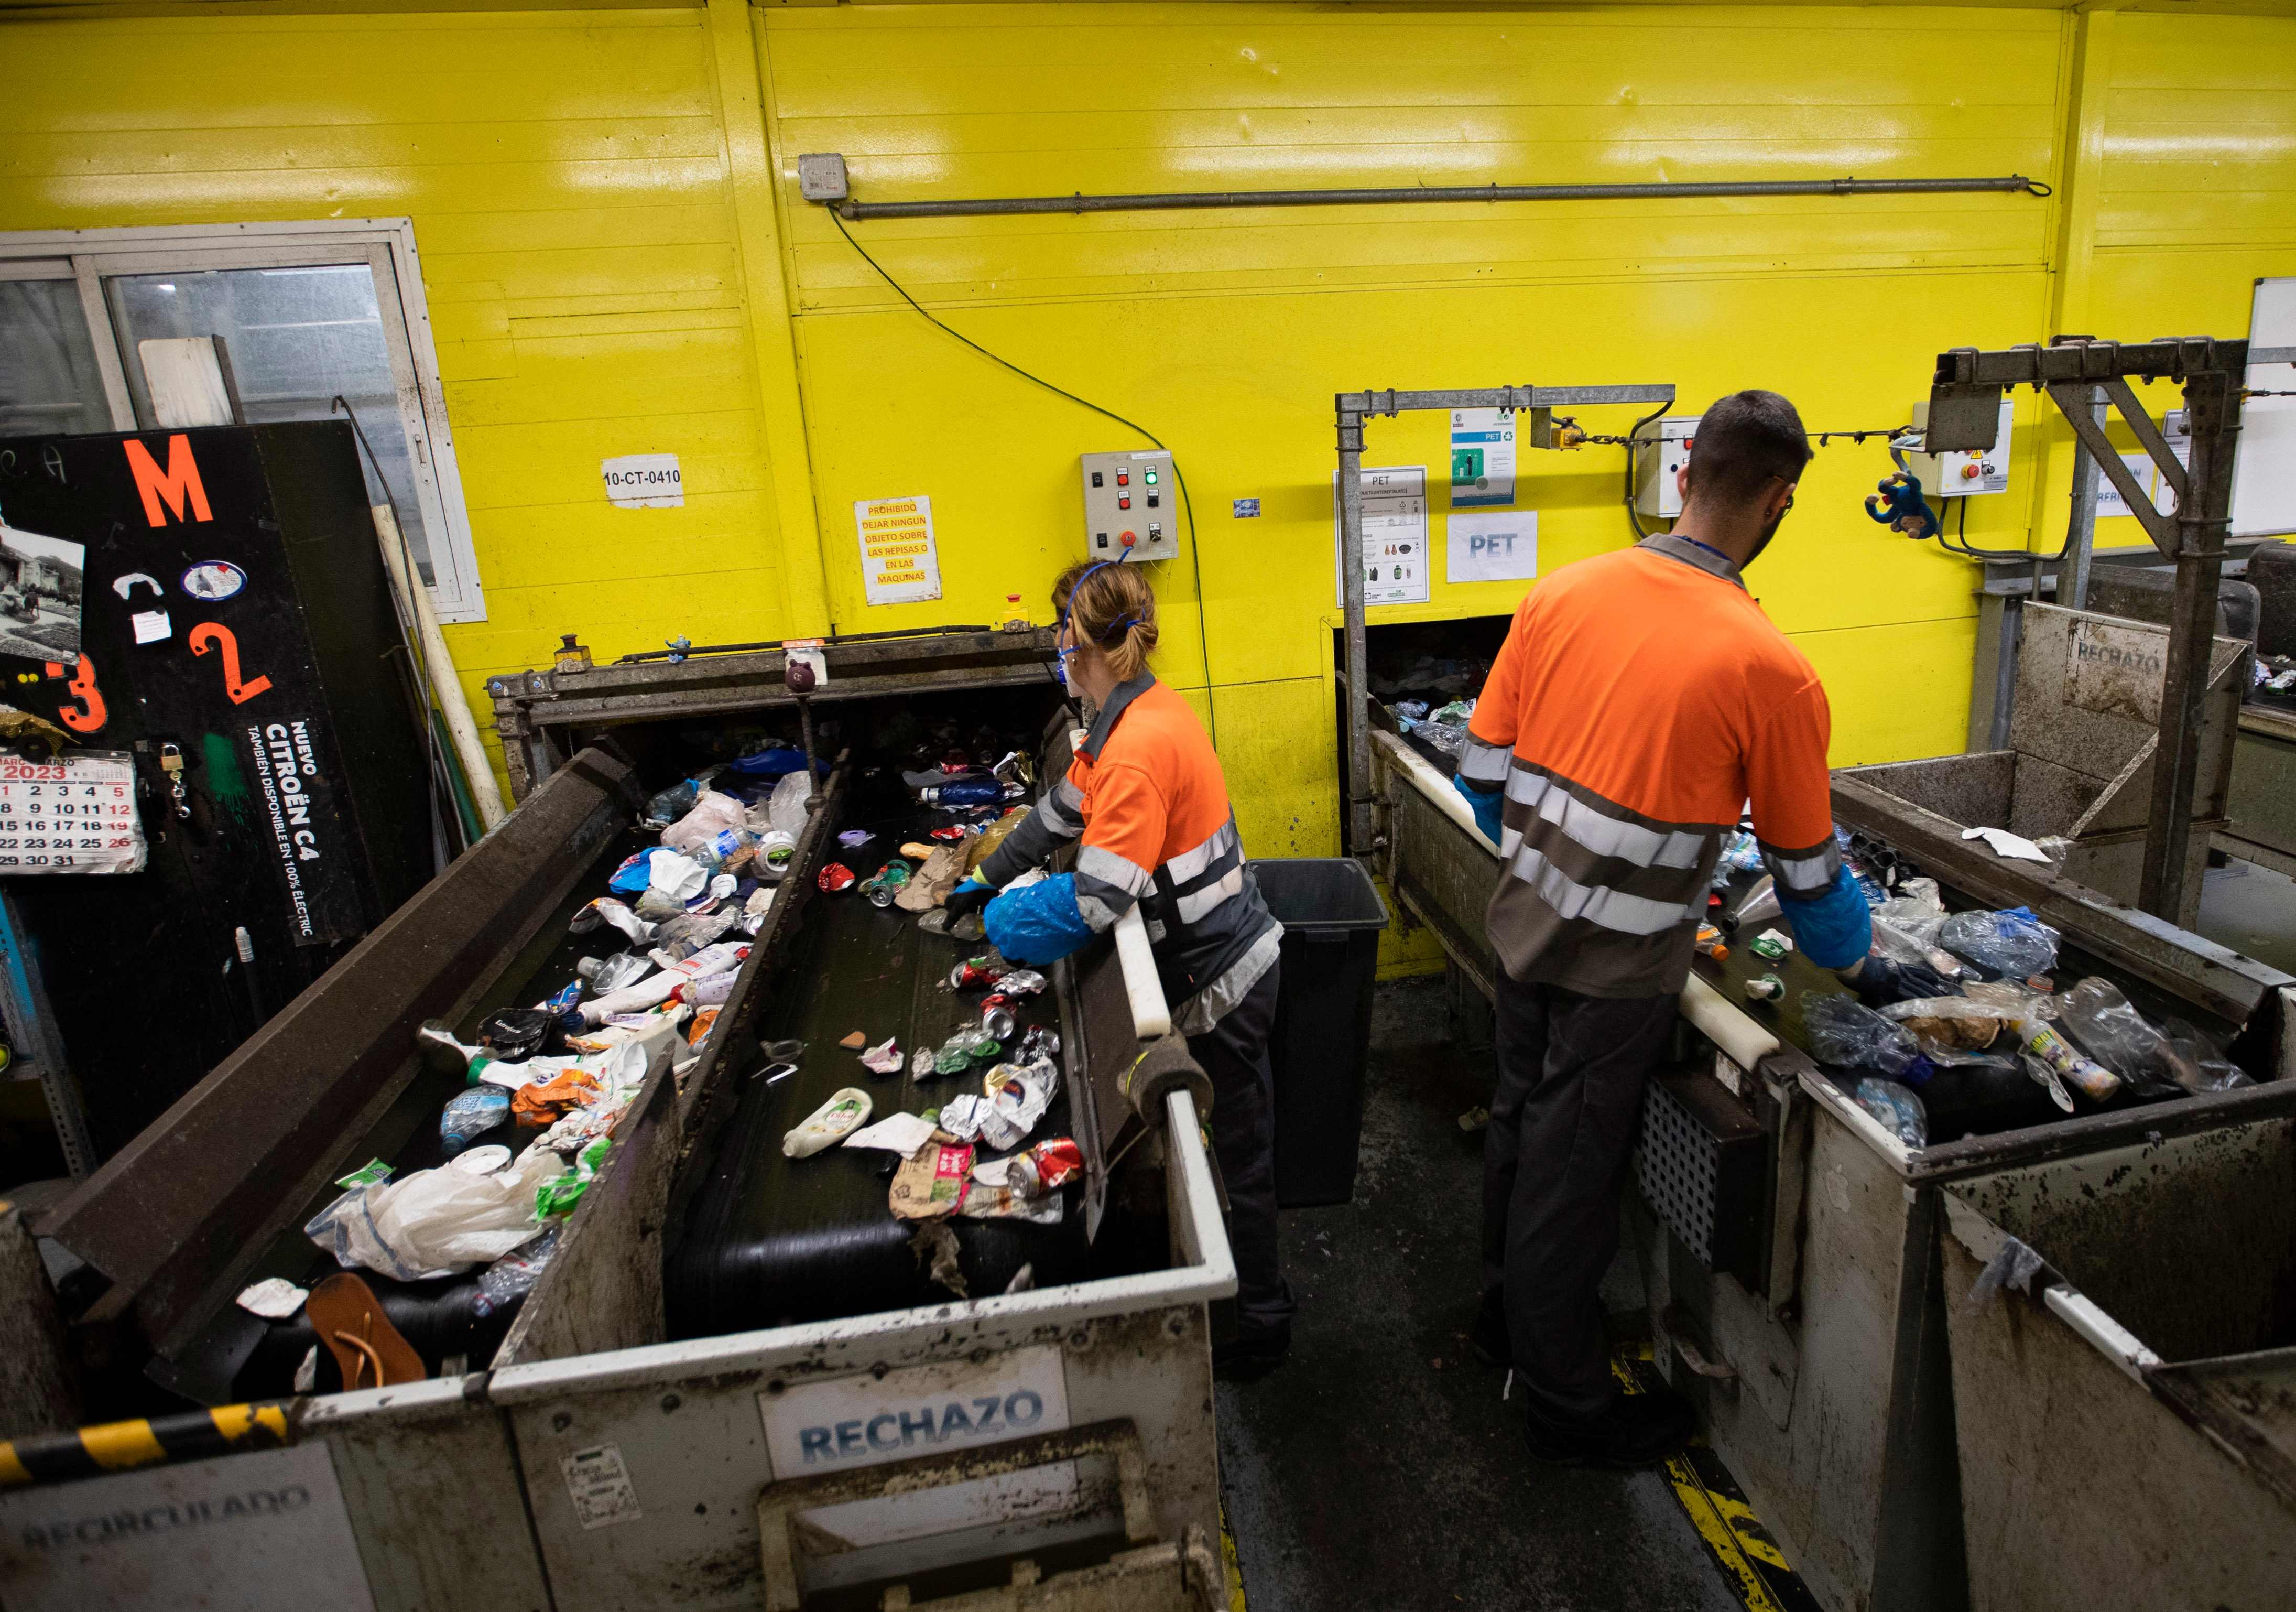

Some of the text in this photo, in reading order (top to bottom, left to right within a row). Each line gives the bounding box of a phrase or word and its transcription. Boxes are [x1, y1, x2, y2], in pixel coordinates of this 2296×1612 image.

[123, 435, 213, 527] M
[604, 470, 680, 486] 10-CT-0410
[1373, 476, 1390, 485] PET
[868, 504, 917, 515] PROHIBIDO
[862, 517, 926, 529] DEJAR NINGUN
[865, 531, 927, 543] OBJETO SOBRE
[868, 548, 883, 557] LAS
[885, 546, 919, 555] REPISAS
[1470, 533, 1518, 558] PET
[877, 572, 925, 583] MAQUINAS
[189, 622, 273, 705] 2
[2078, 642, 2160, 675] RECHAZO
[46, 652, 108, 732] 3
[247, 726, 270, 776] TAMBIÉN
[291, 721, 317, 775] NUEVO
[4, 766, 66, 780] 2023
[2, 786, 124, 797] 1 2 3 4 5
[266, 724, 320, 861] CITROËN C4
[1, 803, 130, 814] 8 9 10 11 12
[262, 777, 288, 841] DISPONIBLE
[25, 821, 46, 830] 16
[53, 821, 74, 830] 17
[82, 821, 102, 830] 18
[108, 822, 128, 830] 19
[25, 839, 46, 848] 23
[53, 839, 74, 848] 24
[80, 839, 101, 848] 25
[108, 838, 130, 848] 26
[279, 843, 293, 858] EN
[26, 856, 48, 865] 30
[54, 856, 73, 865] 31
[285, 861, 301, 889] 100%
[799, 1389, 1043, 1464] RECHAZO
